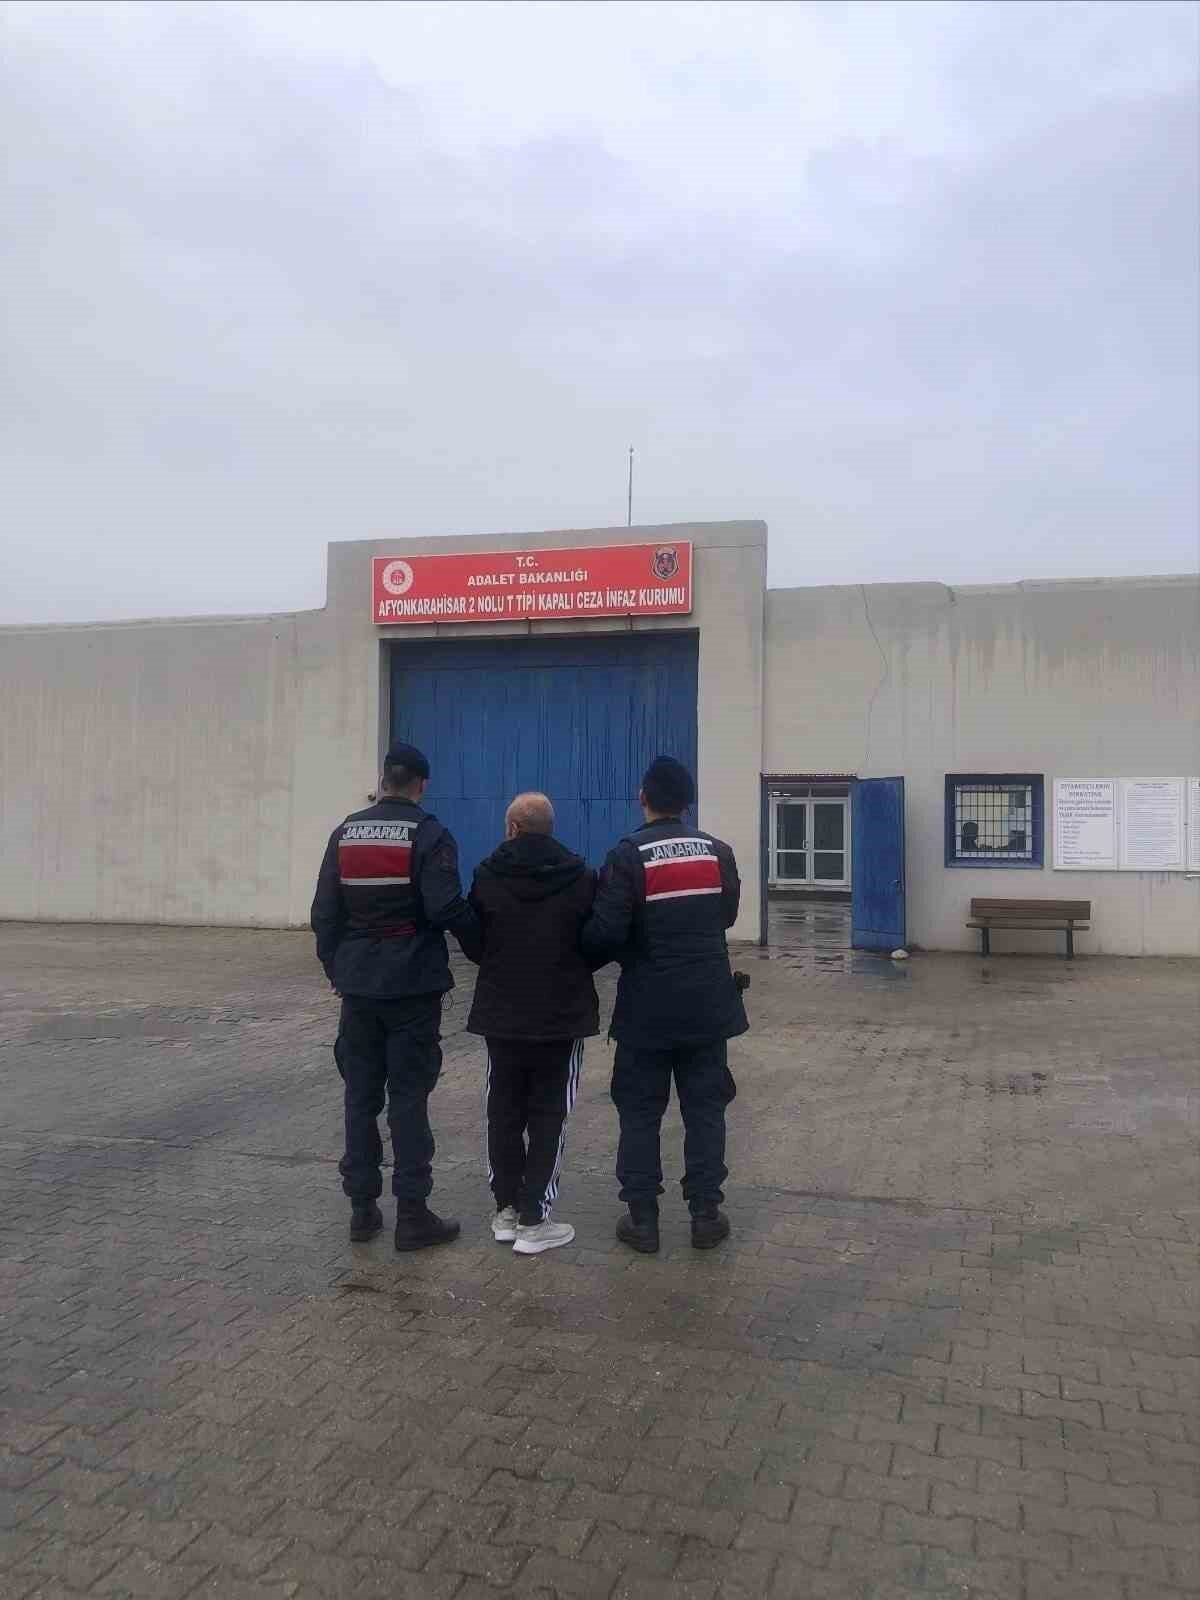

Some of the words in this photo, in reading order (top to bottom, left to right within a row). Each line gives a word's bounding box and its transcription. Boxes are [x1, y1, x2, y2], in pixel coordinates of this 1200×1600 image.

[515, 556, 538, 567] T.C.
[468, 574, 515, 586] ADALET
[519, 570, 588, 584] BAKANLIĞI
[378, 594, 466, 617] AFYONKARAHİSAR
[468, 599, 475, 614] 2
[477, 596, 504, 614] NOLU
[506, 596, 514, 613] T
[516, 590, 536, 612] TİPİ
[538, 591, 573, 611] KAPALI
[577, 590, 603, 609] CEZA
[606, 587, 636, 608] İNFAZ
[639, 587, 685, 607] KURUMU
[342, 826, 409, 840] JANDARMA
[651, 841, 711, 861] JANDARMA
